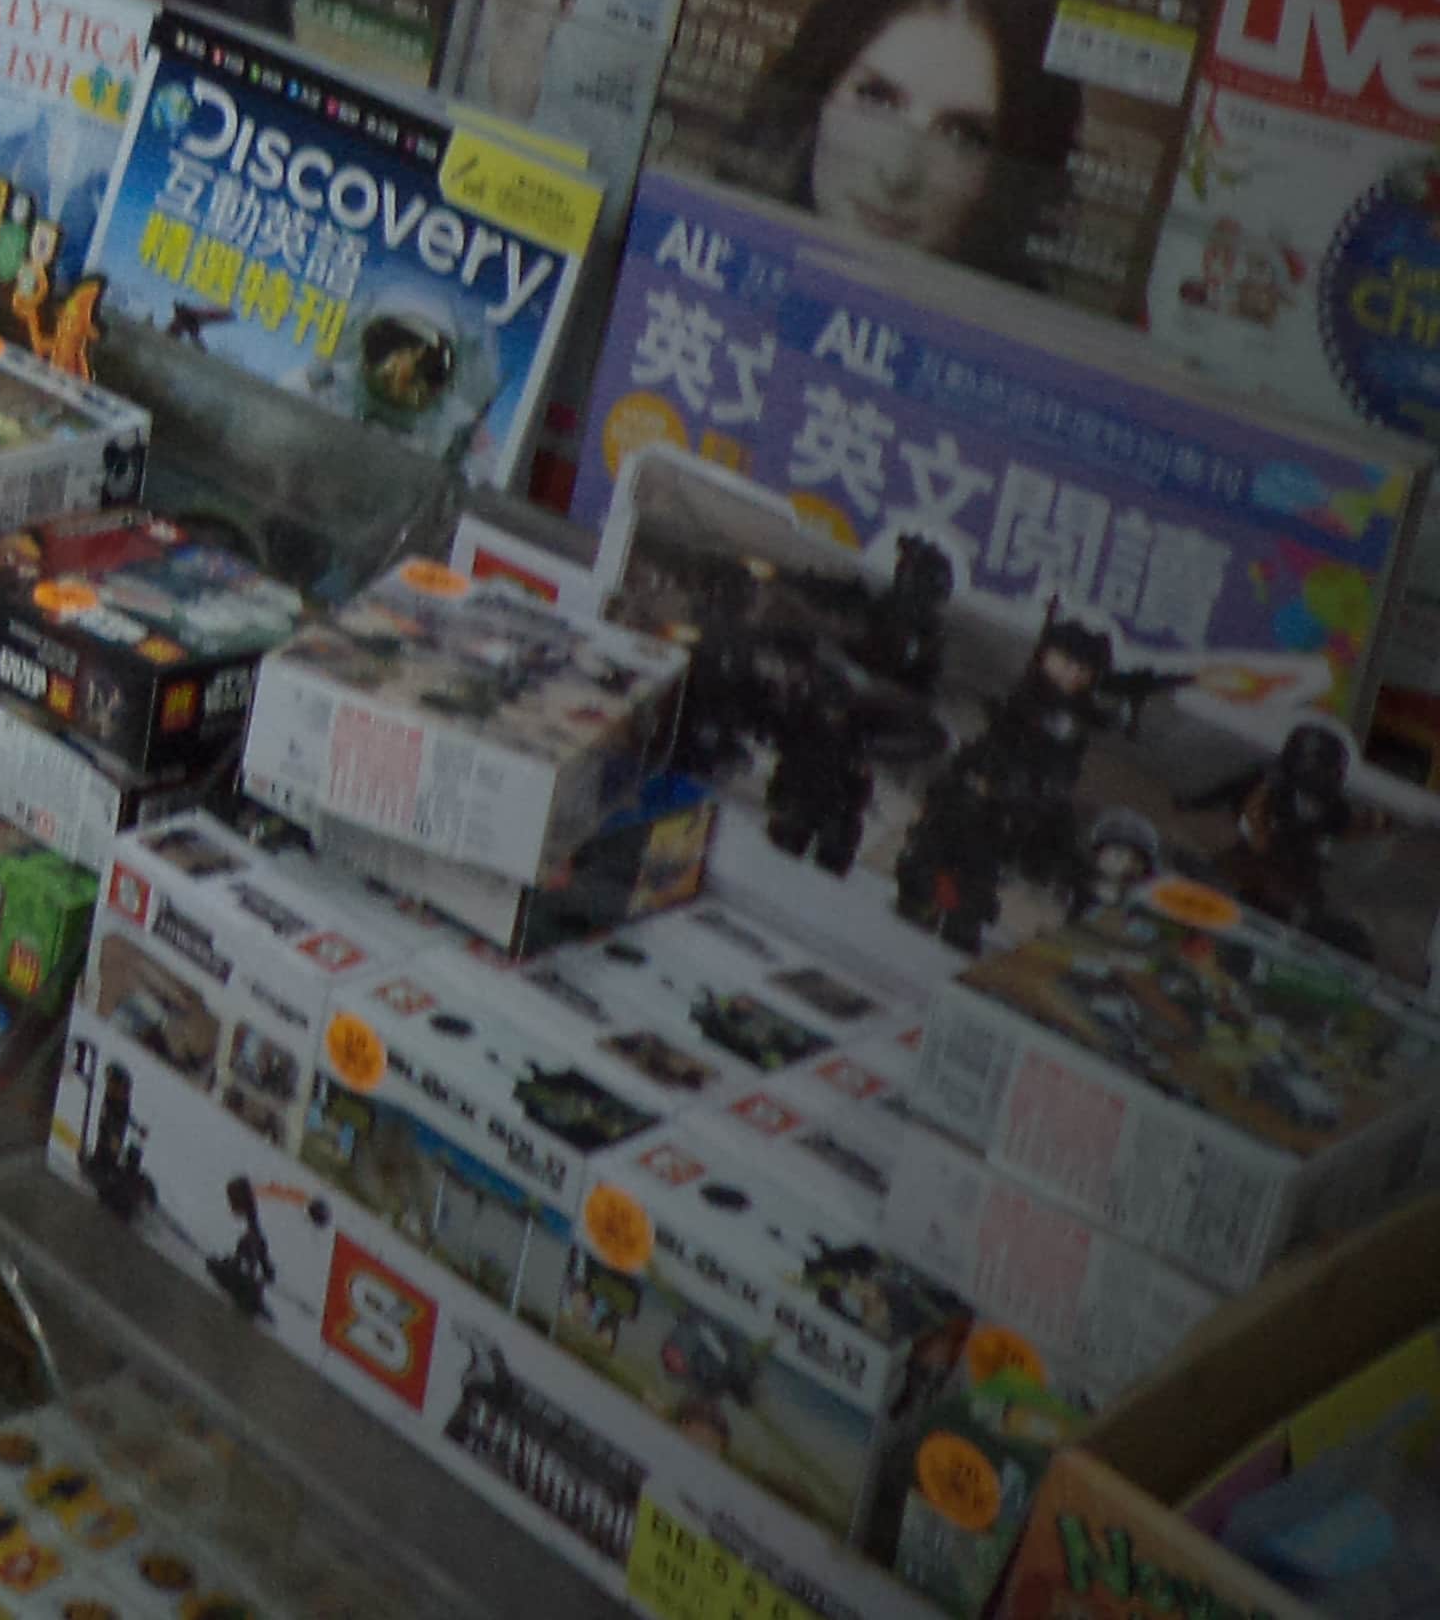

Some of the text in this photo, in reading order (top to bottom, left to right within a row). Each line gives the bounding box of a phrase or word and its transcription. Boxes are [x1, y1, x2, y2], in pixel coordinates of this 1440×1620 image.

[137, 209, 346, 361] 精選特刊
[151, 148, 370, 303] 互動英語
[184, 76, 553, 322] Discovery
[788, 386, 1236, 654] 英文閱讀
